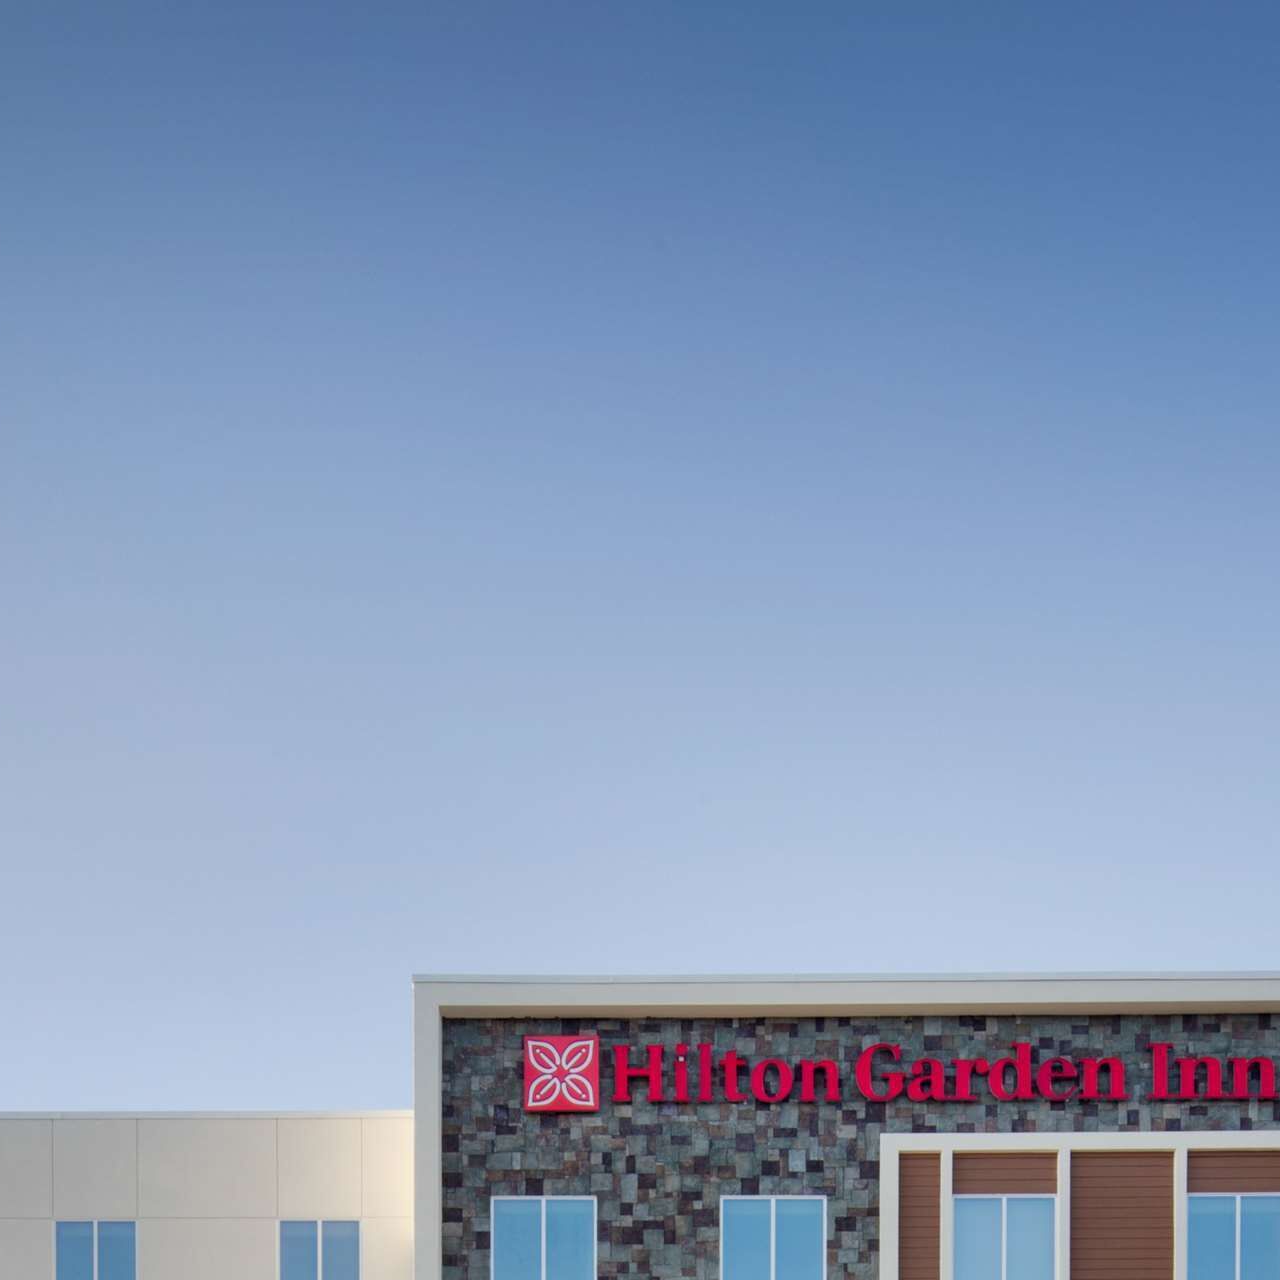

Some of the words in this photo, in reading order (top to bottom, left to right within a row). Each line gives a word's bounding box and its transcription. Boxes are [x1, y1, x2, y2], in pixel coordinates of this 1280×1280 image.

[612, 1042, 841, 1103] Hilton
[854, 1041, 1128, 1102] Garden
[1149, 1042, 1278, 1100] Inn
